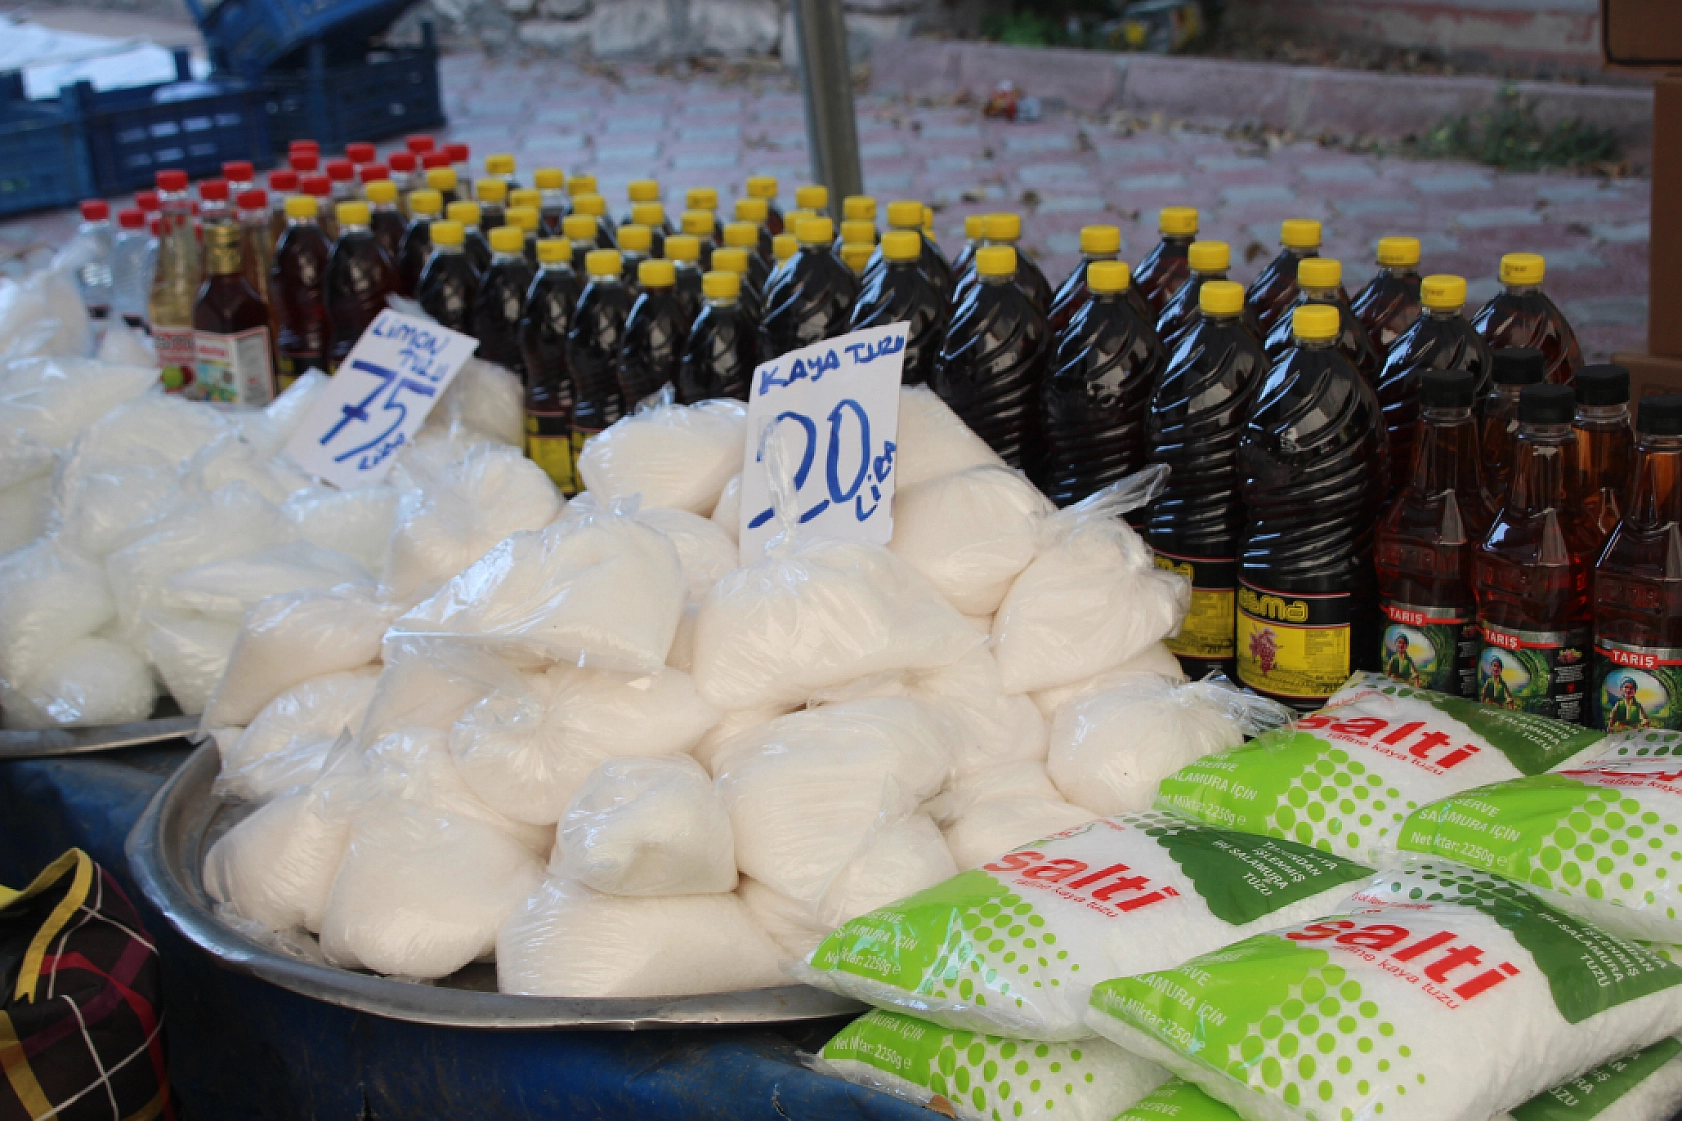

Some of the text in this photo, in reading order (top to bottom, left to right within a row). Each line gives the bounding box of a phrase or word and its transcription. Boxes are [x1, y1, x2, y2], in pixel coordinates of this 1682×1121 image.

[759, 349, 841, 396] KAYA
[319, 358, 436, 462] 75
[747, 398, 871, 529] 20
[1371, 743, 1408, 761] kaya
[1411, 757, 1444, 775] tuzu
[1206, 803, 1236, 826] 2250g
[1489, 824, 1521, 843] İÇİN
[1411, 831, 1432, 846] Net
[1460, 842, 1495, 867] 2250g
[983, 851, 1180, 912] salti
[1286, 919, 1521, 1000] salti
[1558, 923, 1625, 984] SALAMURA
[1580, 952, 1611, 988] TUZU
[1378, 958, 1420, 985] kaya
[1422, 981, 1461, 1010] tuzu
[834, 1036, 848, 1050] Net
[874, 1043, 902, 1070] 2250g
